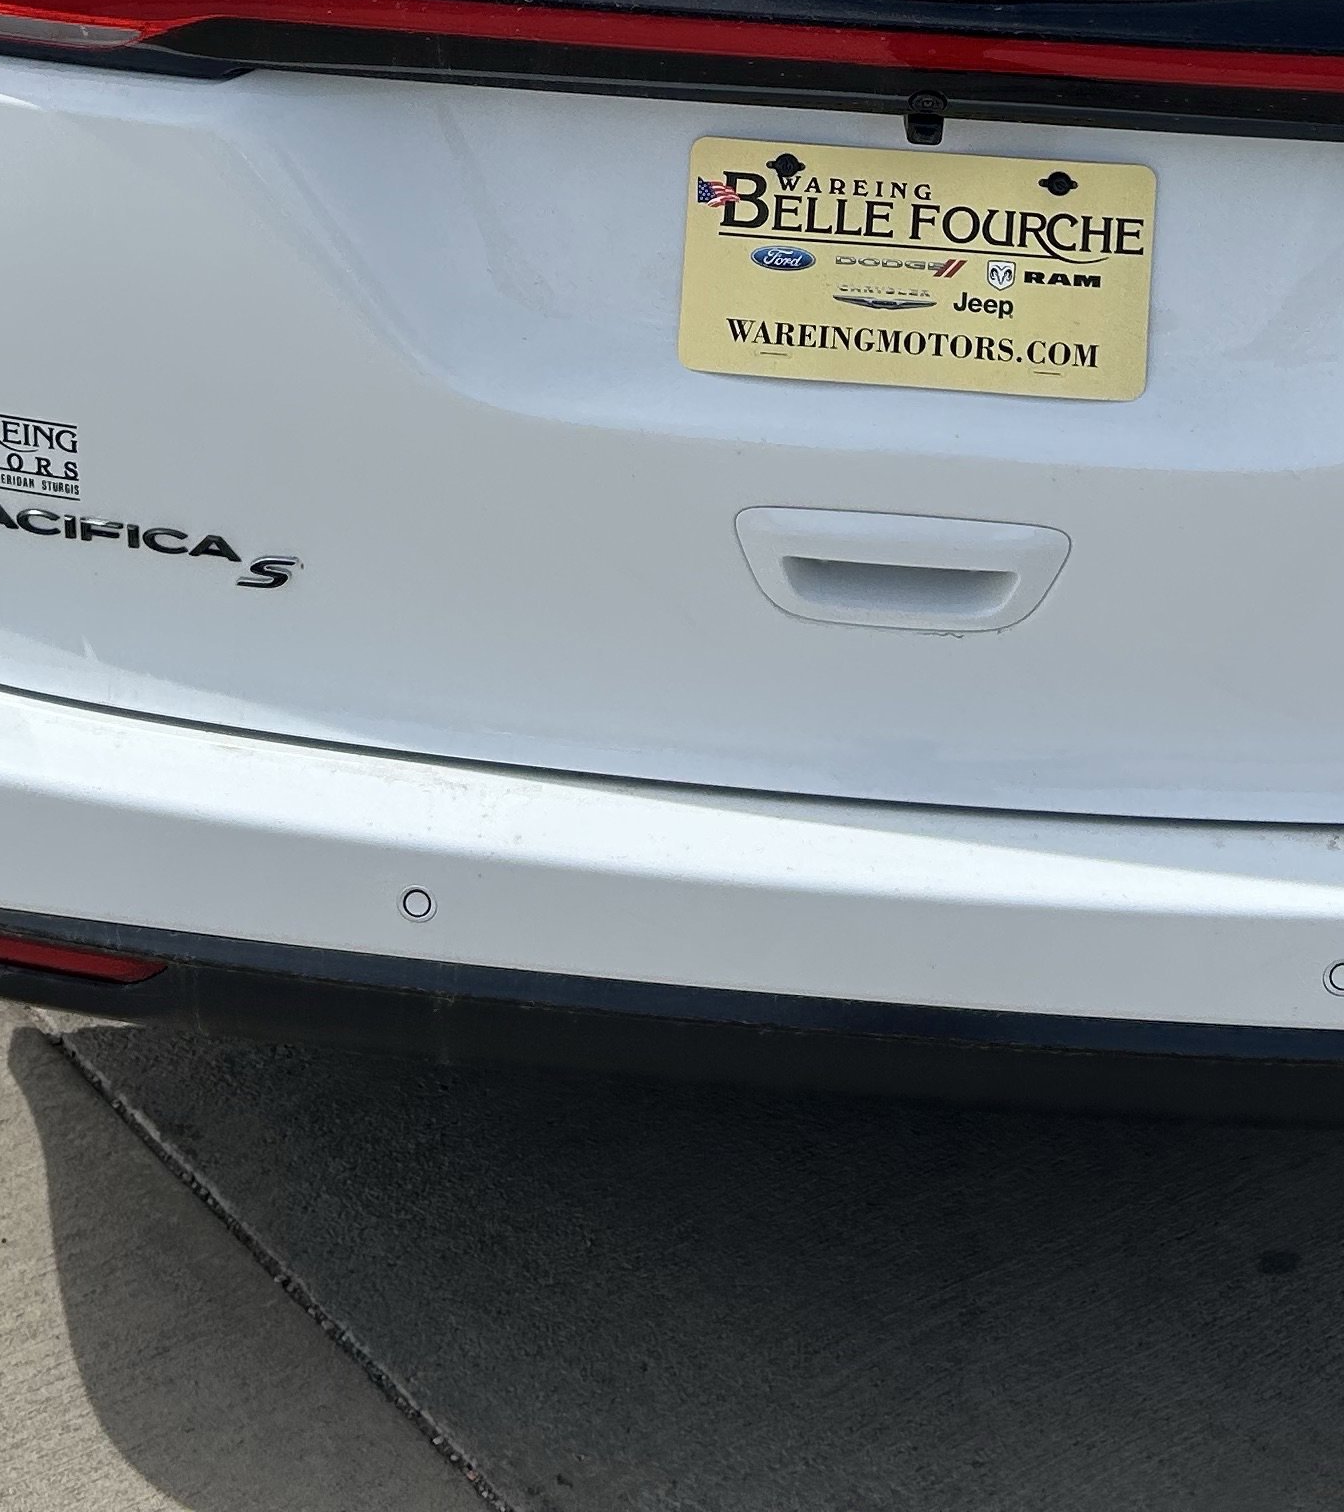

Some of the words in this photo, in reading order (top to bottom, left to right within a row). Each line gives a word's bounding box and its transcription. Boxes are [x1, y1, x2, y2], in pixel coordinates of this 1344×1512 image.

[778, 175, 933, 201] WAREING
[719, 170, 894, 238] BELLE
[908, 203, 1145, 263] FOURCHE
[762, 249, 804, 269] Ford
[834, 255, 949, 272] DODGE
[1023, 269, 1102, 288] RAM
[953, 291, 1014, 318] Jeep
[726, 317, 1099, 368] WAREINGMOTORS.COM
[41, 479, 80, 496] STURGIS
[236, 555, 304, 589] S
